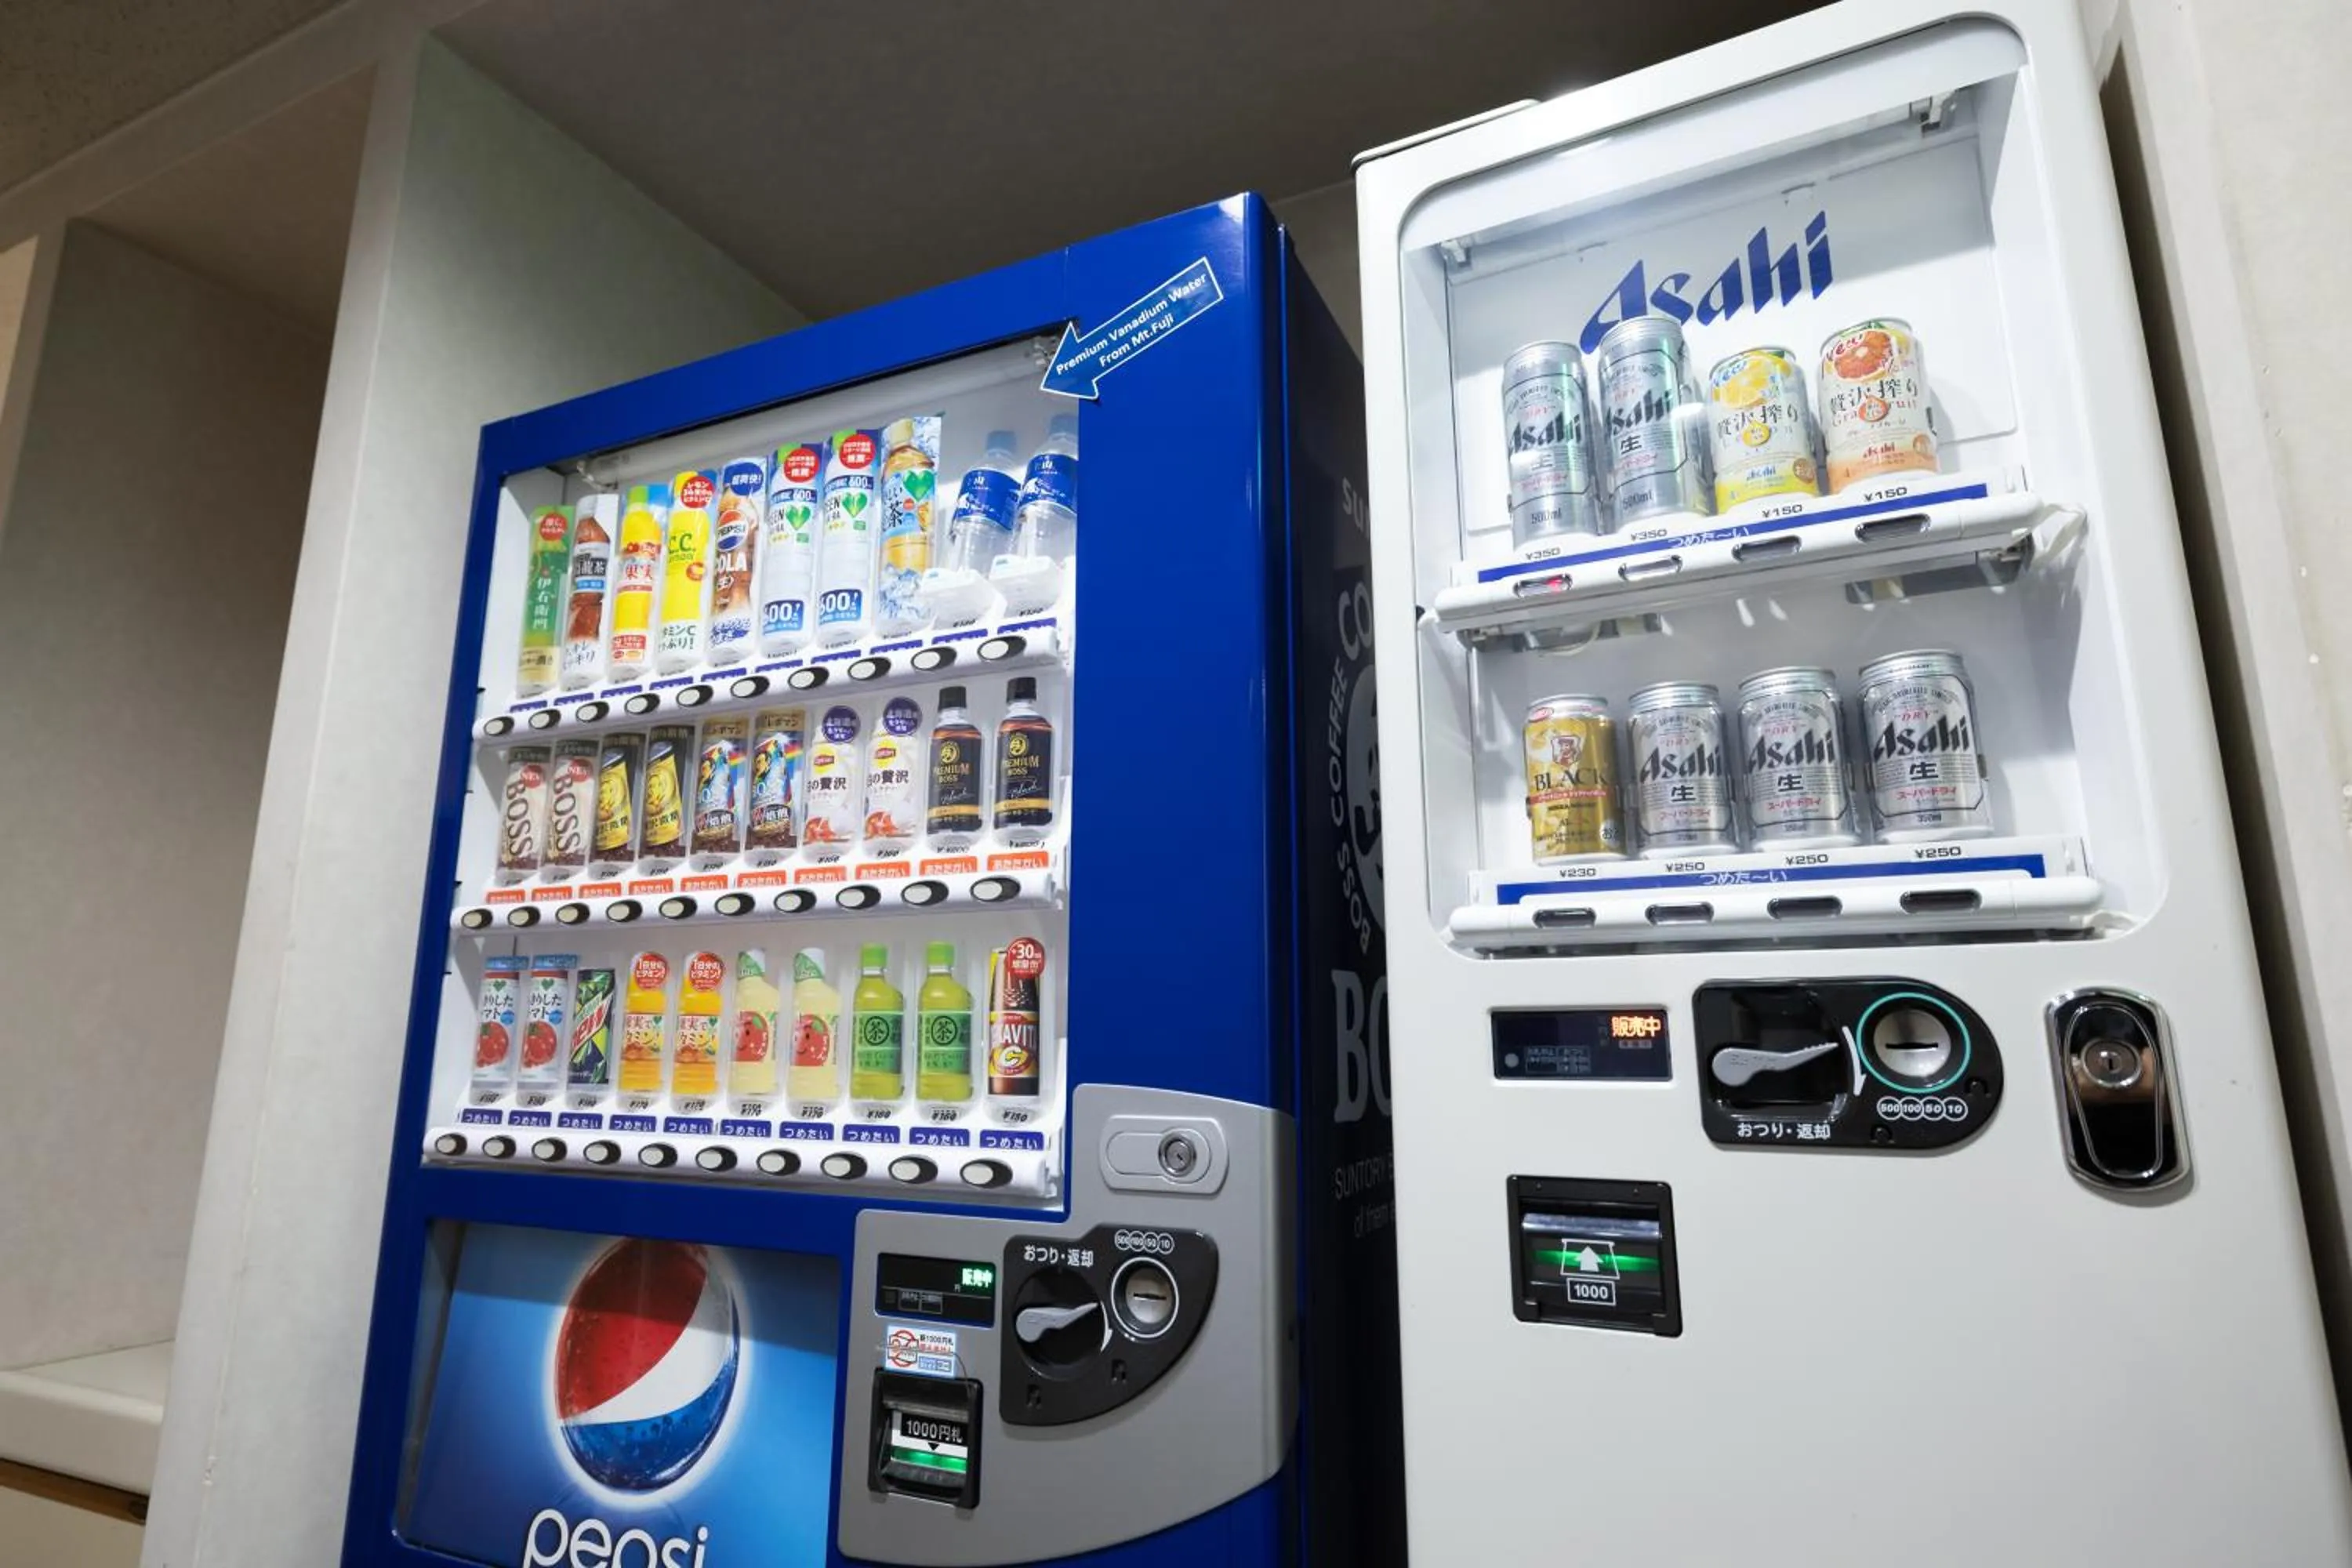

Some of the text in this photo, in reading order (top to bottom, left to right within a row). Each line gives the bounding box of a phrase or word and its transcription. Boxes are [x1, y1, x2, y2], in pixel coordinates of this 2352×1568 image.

[1580, 210, 1833, 354] Asahi
[1056, 273, 1207, 375] Premium Vanadium Water
[1099, 313, 1174, 368] From Mt.Fuji
[1508, 412, 1582, 455] Asahi
[1621, 436, 1642, 455] 生
[1864, 487, 1908, 503] ¥150
[1342, 476, 1370, 541] SU
[1762, 503, 1803, 518] ¥150
[1631, 528, 1668, 541] ¥350
[717, 551, 747, 574] OLA
[1526, 548, 1561, 561] ¥350
[1873, 715, 1969, 764] Asahi
[1748, 728, 1836, 774] Asahi
[1640, 744, 1722, 783] Asahi
[1909, 761, 1939, 781] 生
[1777, 774, 1804, 793] 生
[1671, 786, 1697, 802] 生
[553, 773, 581, 852] BOSS
[1328, 657, 1371, 954] BOSS COFFEE
[506, 780, 534, 856] BOSS
[1785, 853, 1830, 866] ¥250
[1915, 846, 1962, 859] ¥250
[1559, 867, 1597, 878] ¥230
[1665, 862, 1706, 873] ¥250
[866, 1018, 887, 1044] 茶
[934, 1018, 955, 1044] 茶
[1611, 1016, 1661, 1037] 販売中
[1882, 1104, 1962, 1113] 500 100 50 10
[466, 1112, 499, 1123] つめたい
[513, 1115, 548, 1127] つめたい
[561, 1117, 599, 1129] つめたい
[615, 1120, 652, 1131] つめたい
[669, 1122, 709, 1134] つめたい
[724, 1124, 767, 1137] つめたい
[784, 1127, 829, 1140] つめたい
[848, 1130, 895, 1142] つめたい
[1737, 1123, 1832, 1140] おつり・返却
[915, 1133, 964, 1145] つめたい
[985, 1136, 1038, 1149] つめたい
[1161, 1239, 1171, 1249] 10
[1024, 1245, 1095, 1268] おつり・返却
[1574, 1284, 1609, 1299] 1000
[906, 1420, 963, 1443] 1000円札
